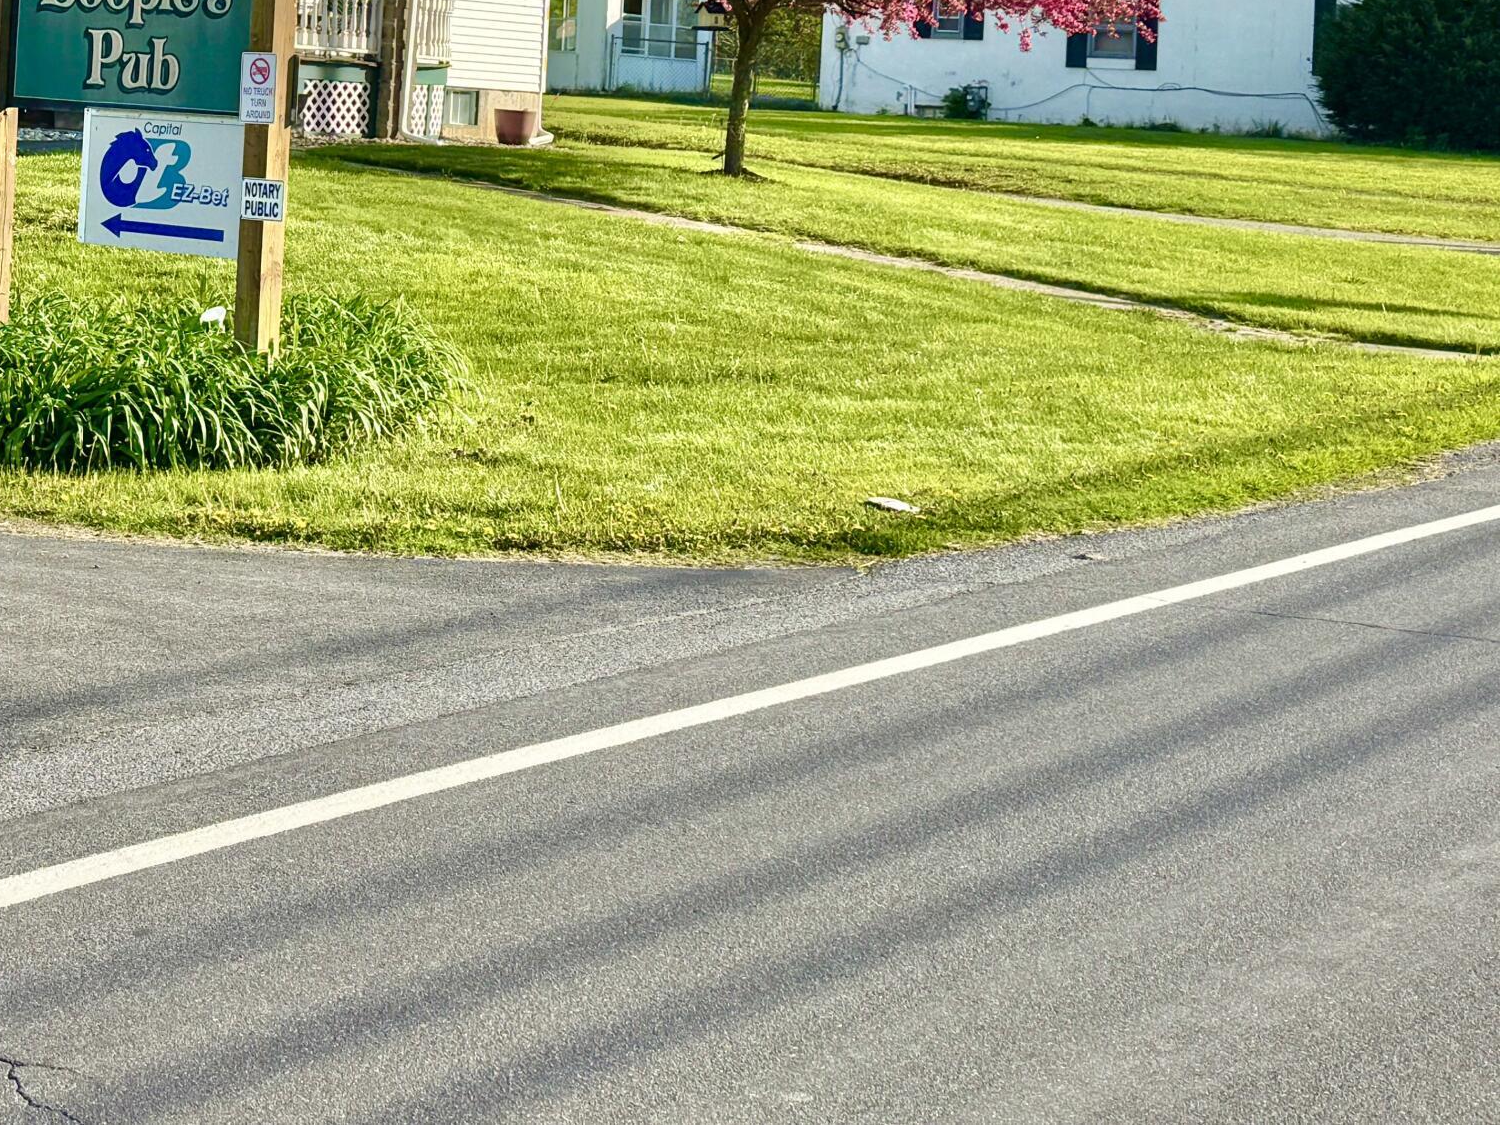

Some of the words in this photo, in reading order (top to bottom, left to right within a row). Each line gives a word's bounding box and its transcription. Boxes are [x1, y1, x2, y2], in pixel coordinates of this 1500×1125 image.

[85, 28, 180, 91] Pub
[243, 87, 253, 95] NO
[253, 87, 273, 96] TRUCK
[250, 98, 267, 107] TURN
[245, 110, 271, 119] AROUND
[143, 121, 183, 136] Capital
[171, 183, 229, 207] EZ-Bet
[244, 181, 281, 199] NOTARY
[244, 200, 279, 218] PUBLIC
